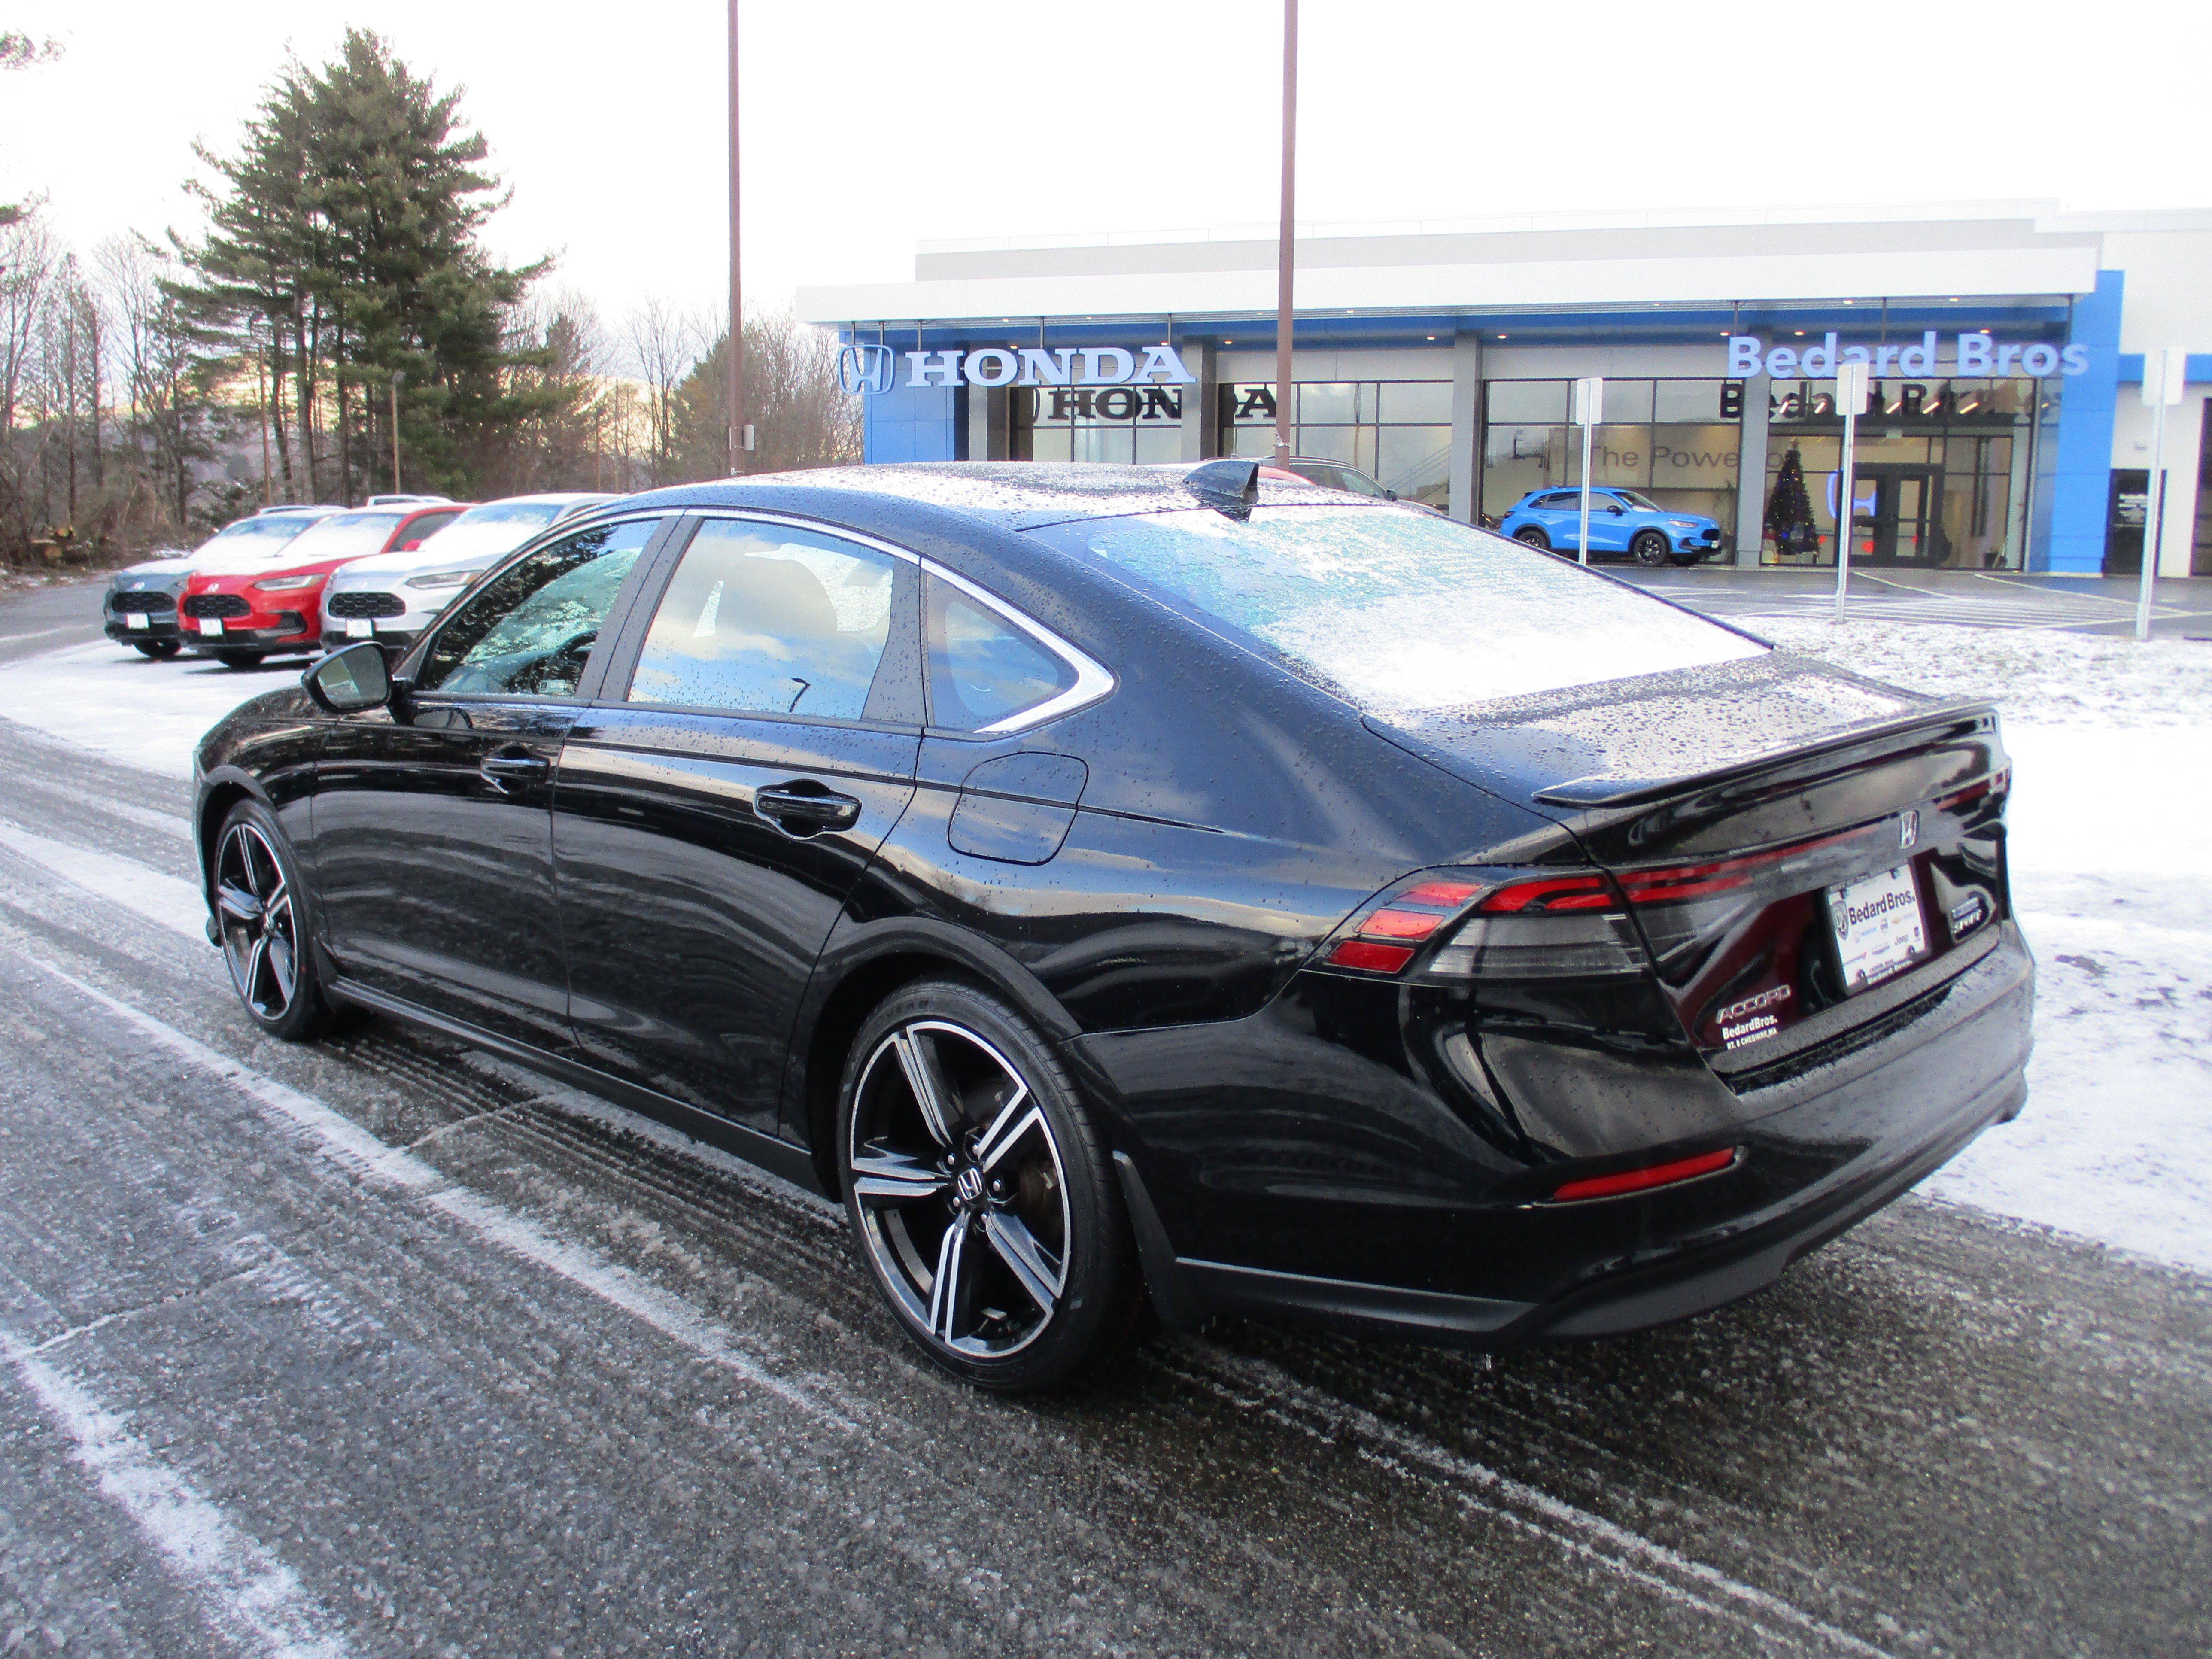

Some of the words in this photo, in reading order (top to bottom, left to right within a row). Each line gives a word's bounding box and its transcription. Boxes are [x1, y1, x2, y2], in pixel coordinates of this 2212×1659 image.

[905, 346, 1197, 387] HONDA
[1728, 330, 1936, 379] Bedard
[1957, 332, 2090, 377] Bros
[1715, 984, 1791, 1024] ACCORD
